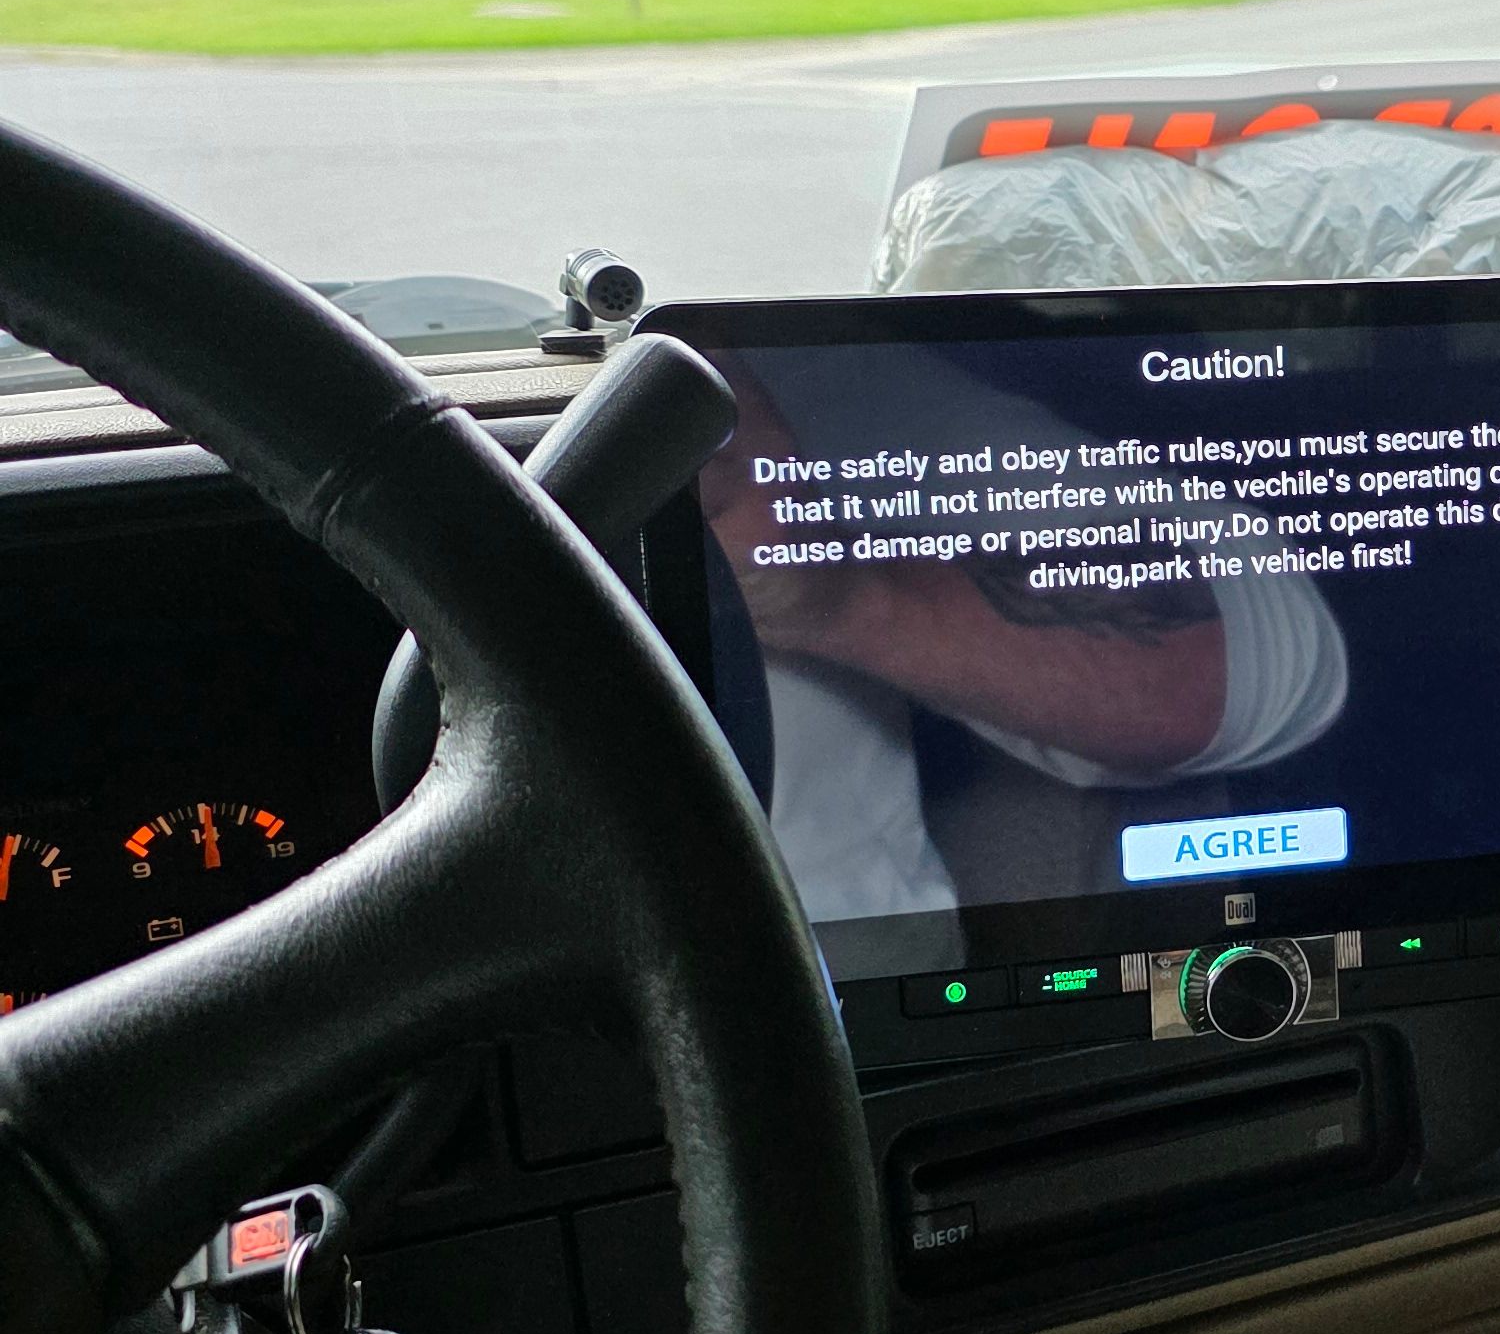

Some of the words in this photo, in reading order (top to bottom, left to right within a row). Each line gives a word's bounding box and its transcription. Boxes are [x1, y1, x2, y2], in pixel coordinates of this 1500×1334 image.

[1141, 345, 1285, 383] Caution!
[753, 456, 832, 484] Drive
[840, 449, 930, 483] safely
[938, 445, 993, 475] and
[1001, 444, 1071, 475] obey
[1077, 438, 1161, 468] traffic
[1168, 436, 1292, 466] rules,you
[1299, 430, 1369, 457] must
[1376, 429, 1465, 453] secure
[771, 496, 835, 524] that
[841, 494, 865, 520] it
[869, 489, 921, 519] will
[930, 489, 979, 516] not
[986, 482, 1107, 512] interfere
[1114, 477, 1174, 505] with
[1180, 475, 1227, 502] the
[1233, 467, 1351, 499] vechile's
[1358, 462, 1482, 497] operating
[753, 540, 845, 566] cause
[852, 532, 973, 561] damage
[980, 531, 1012, 553] or
[1019, 517, 1141, 557] personal
[1150, 512, 1270, 548] injury.Do
[1277, 510, 1323, 535] not
[1329, 504, 1430, 537] operate
[1435, 499, 1485, 526] this
[1028, 554, 1193, 590] driving,park
[1197, 552, 1243, 578] the
[1250, 545, 1345, 575] vehicle
[1350, 539, 1413, 569] first!
[267, 841, 295, 858] 19
[1174, 824, 1300, 863] AGREE
[51, 866, 72, 888] F
[131, 861, 152, 879] 9
[1228, 898, 1254, 920] Dual
[1053, 967, 1098, 982] SOURCE
[912, 1224, 969, 1251] EJECT
